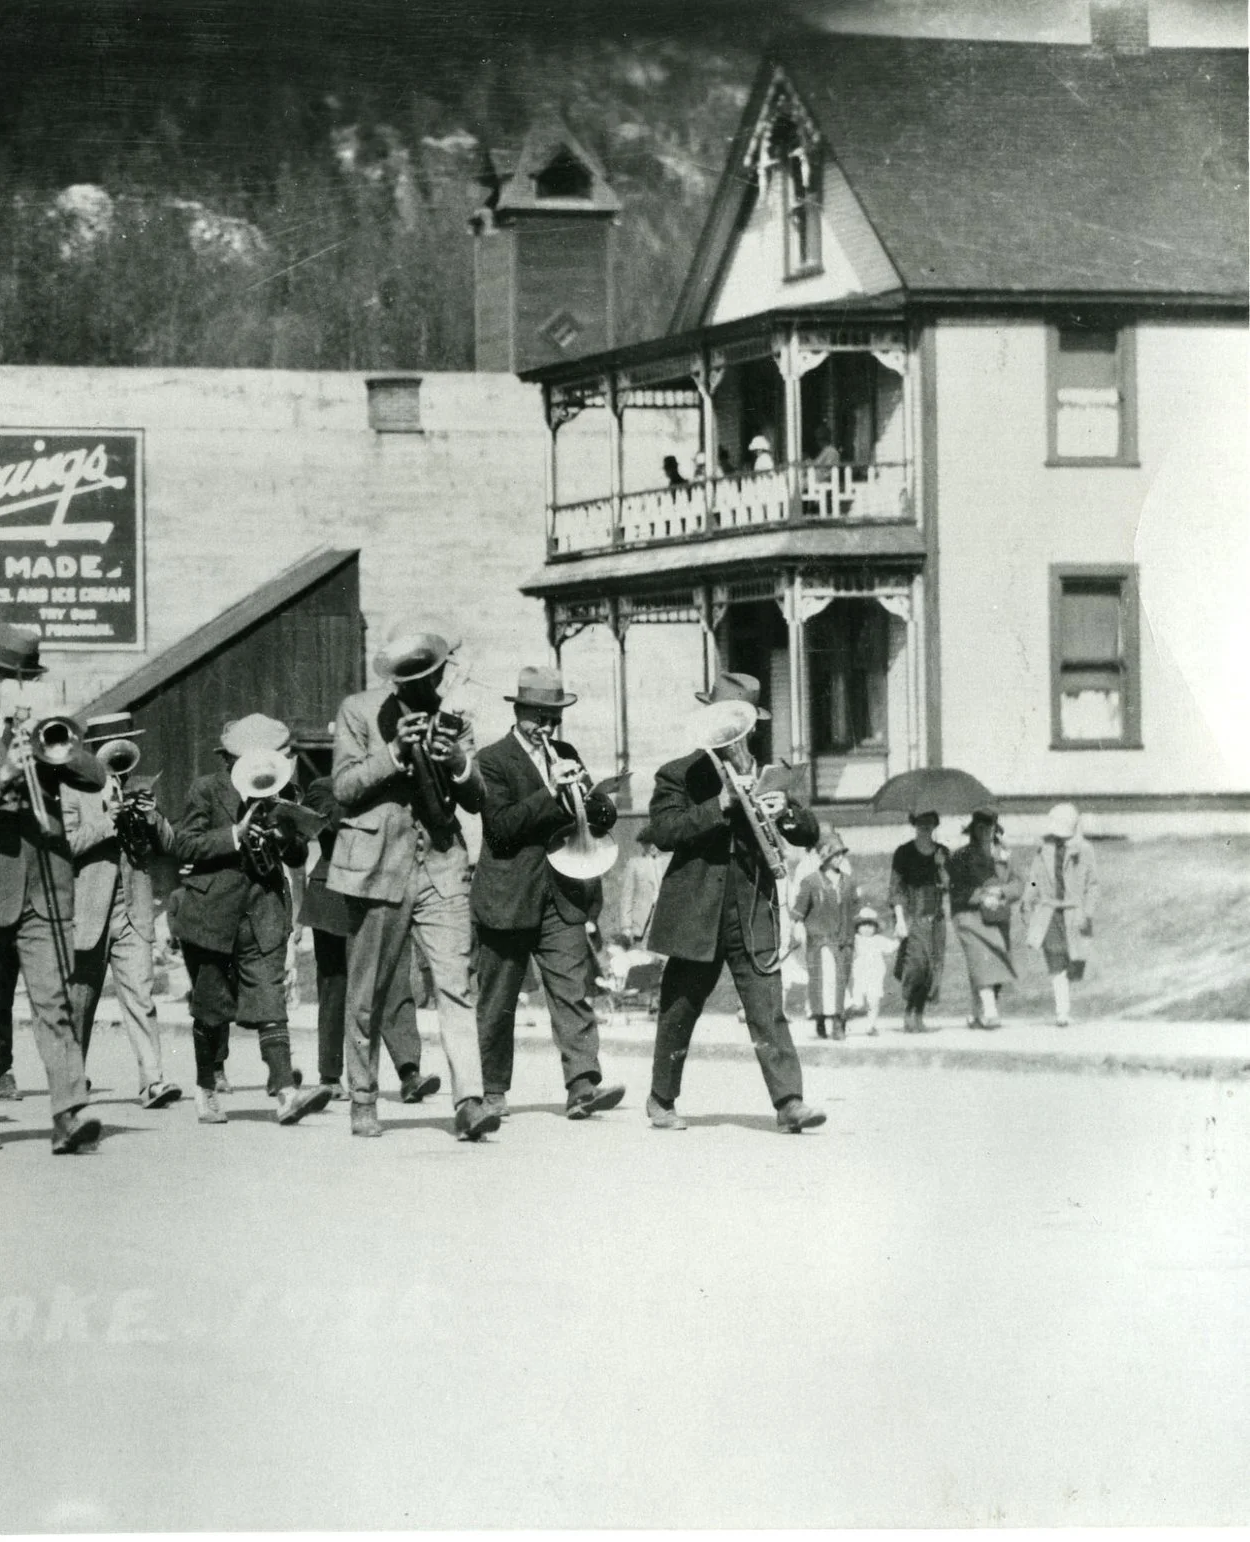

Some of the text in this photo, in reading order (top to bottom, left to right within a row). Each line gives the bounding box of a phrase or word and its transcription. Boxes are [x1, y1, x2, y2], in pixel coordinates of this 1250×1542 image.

[5, 555, 103, 579] MADE
[16, 587, 49, 603] AND
[50, 587, 77, 603] ICE
[79, 587, 131, 603] CREAM
